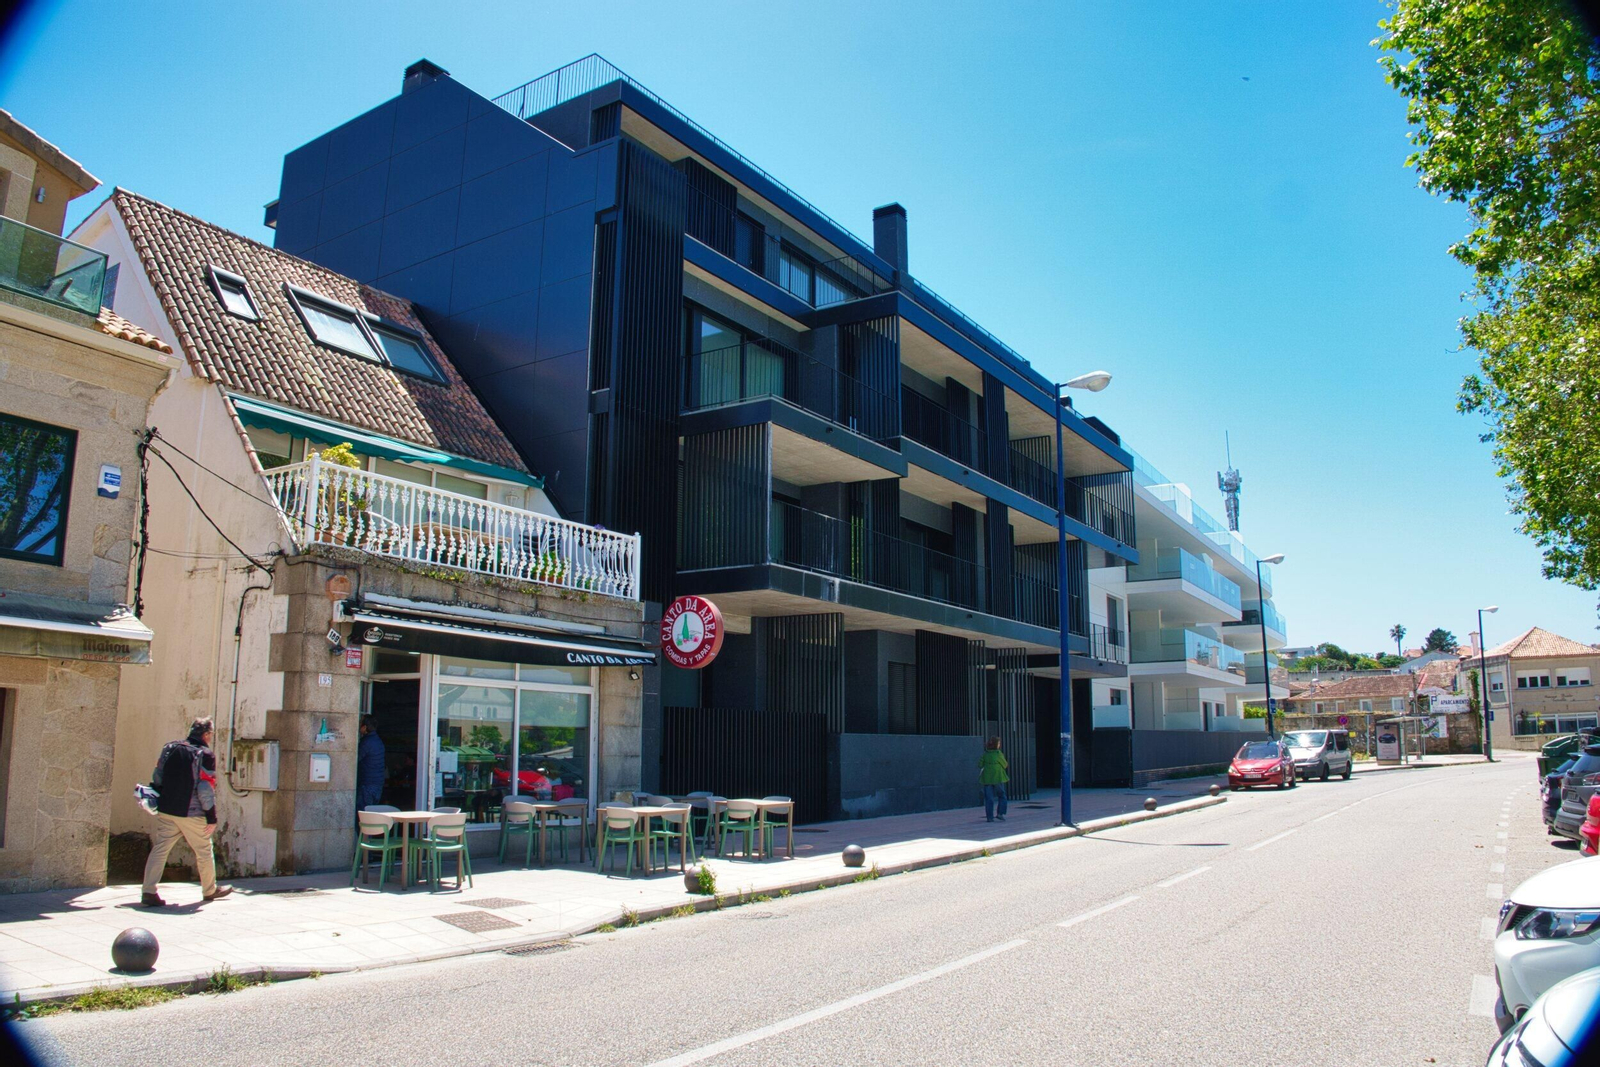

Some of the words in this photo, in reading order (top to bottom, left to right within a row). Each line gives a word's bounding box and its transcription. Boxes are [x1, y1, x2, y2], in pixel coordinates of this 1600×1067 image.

[662, 602, 682, 641] CANTO
[685, 598, 698, 611] DA
[698, 606, 716, 639] AREA
[566, 652, 604, 664] CANTO
[605, 656, 623, 664] DA
[665, 645, 687, 665] COMIDAS
[695, 644, 711, 662] TAPAS
[1431, 696, 1437, 705] P
